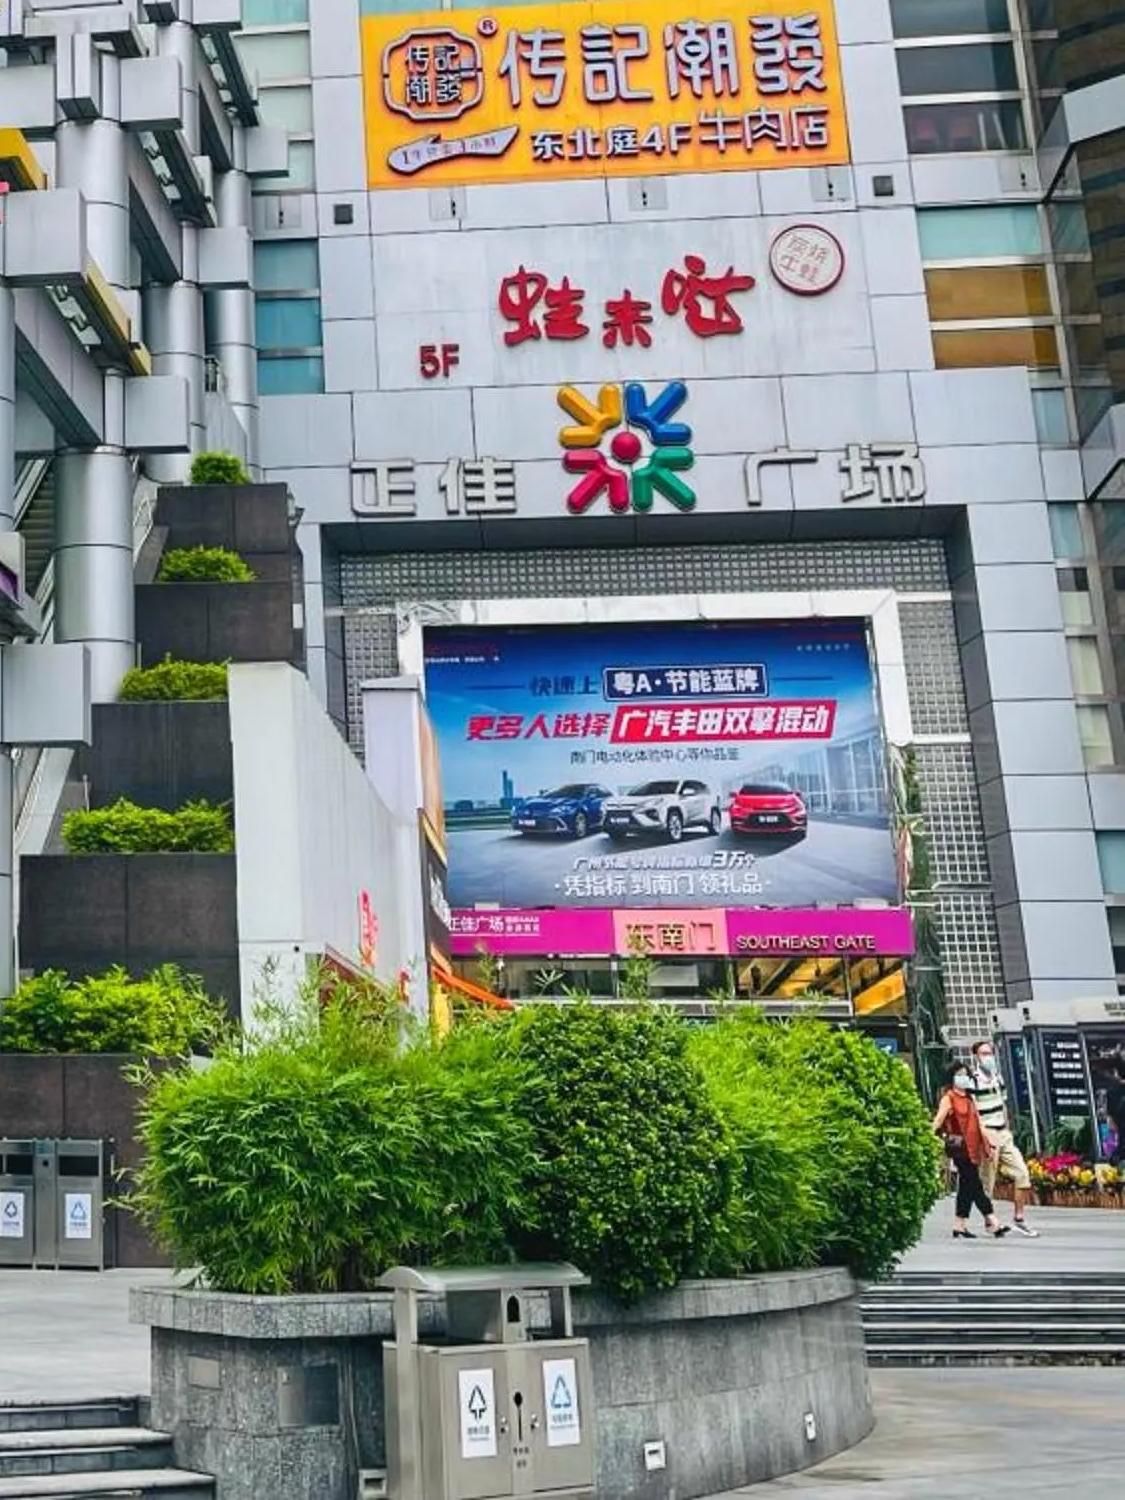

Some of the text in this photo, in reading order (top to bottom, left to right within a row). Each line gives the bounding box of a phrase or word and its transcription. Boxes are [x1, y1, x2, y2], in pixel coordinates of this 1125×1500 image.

[419, 344, 460, 378] 5F
[350, 442, 928, 517] 正佳 广场
[467, 705, 829, 741] 更多人选择 广汽丰田双擎混动
[626, 921, 715, 951] 东南门
[736, 934, 876, 949] SOUTHEAST GATE
